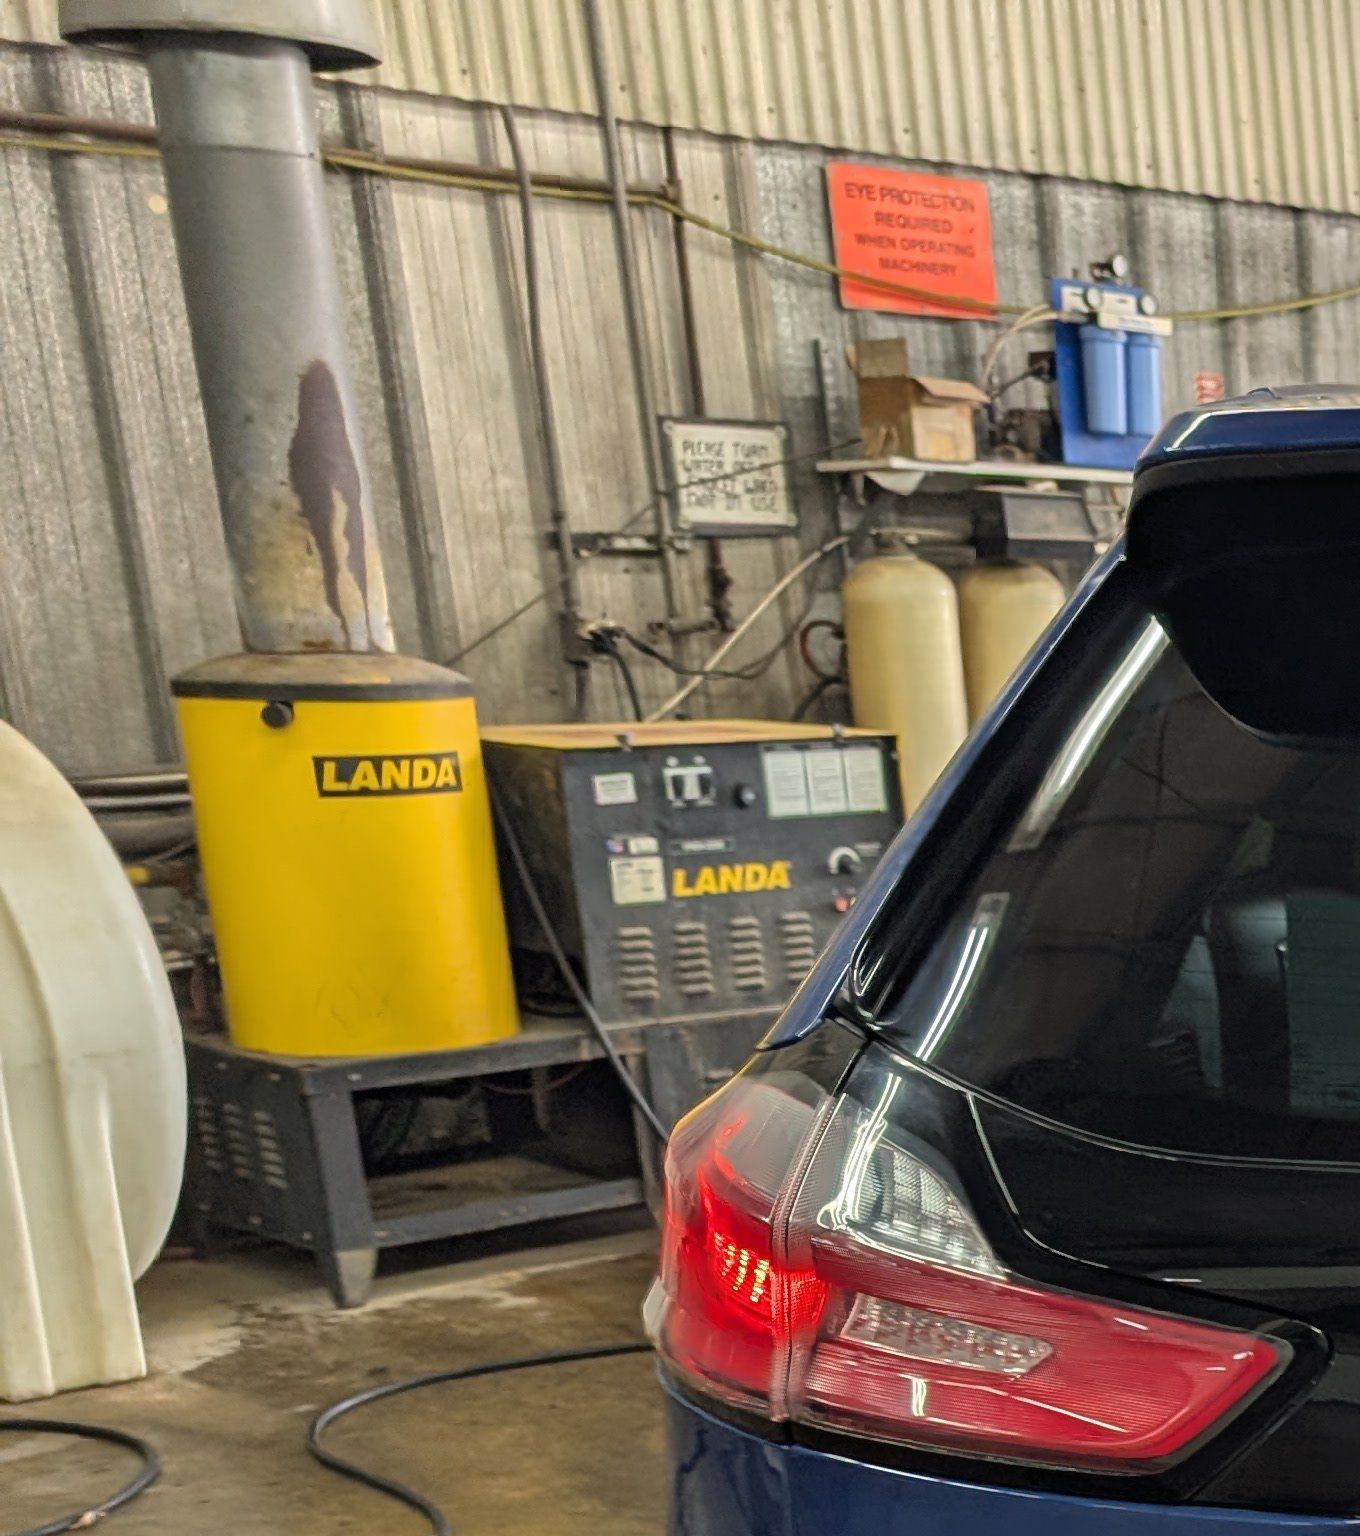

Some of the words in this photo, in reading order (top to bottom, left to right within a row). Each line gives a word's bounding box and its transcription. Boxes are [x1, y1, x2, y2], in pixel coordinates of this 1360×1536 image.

[844, 182, 876, 201] EYE
[879, 186, 976, 212] PROTECTION
[874, 211, 953, 234] REQUIRED
[855, 233, 896, 249] WHEN
[900, 238, 976, 257] OPERATING
[879, 257, 957, 276] MACHINERY
[323, 758, 457, 791] LANDA
[672, 860, 791, 897] LANDA
